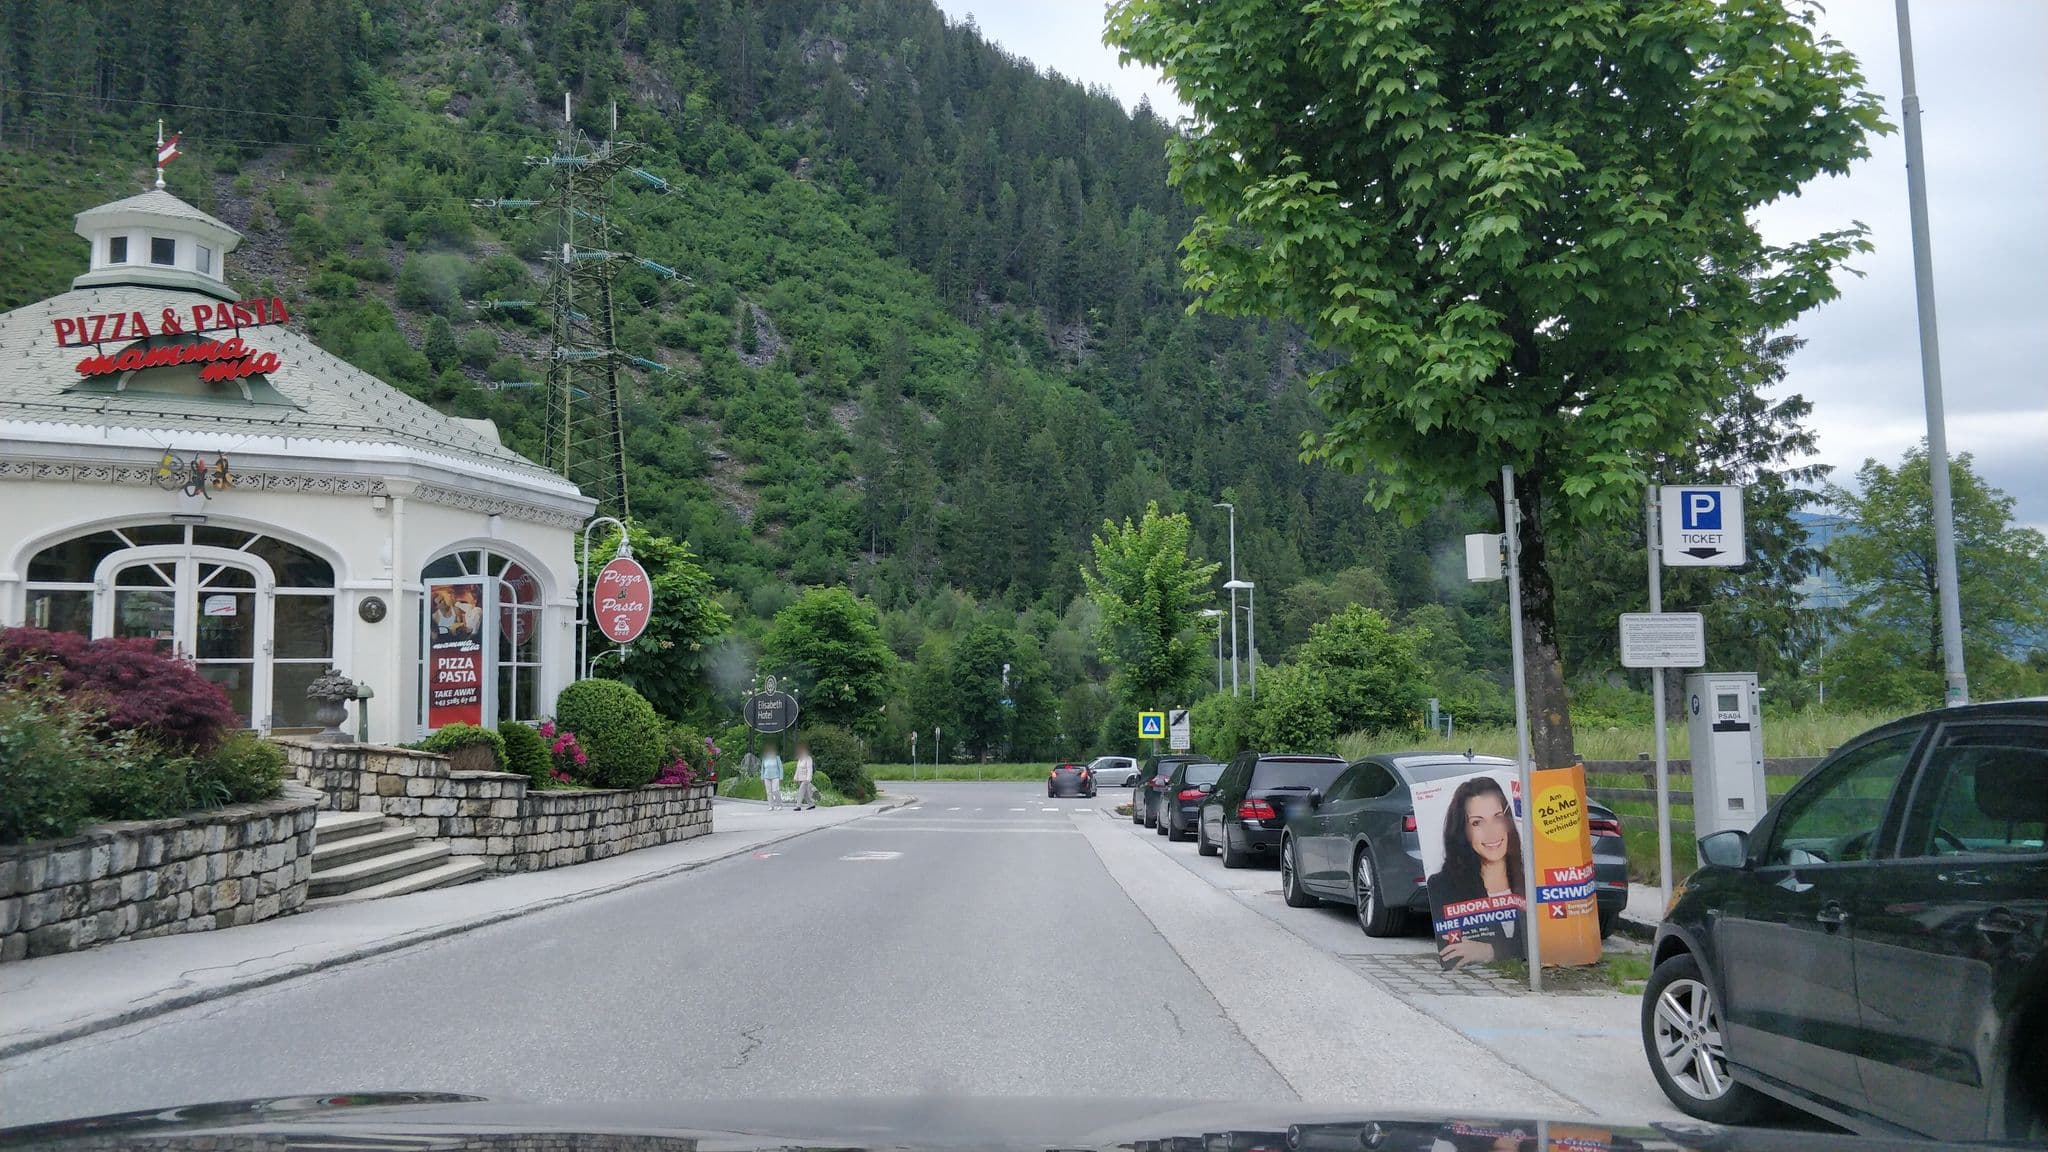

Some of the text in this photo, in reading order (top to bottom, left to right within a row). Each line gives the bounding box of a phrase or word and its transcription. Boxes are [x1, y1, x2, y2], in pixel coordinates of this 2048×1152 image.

[53, 296, 289, 347] PIZZA & PASTA
[75, 337, 250, 376] mamma
[200, 349, 281, 382] mia
[1690, 494, 1715, 527] P
[1681, 534, 1723, 544] TICKET
[604, 570, 642, 586] Pizza
[602, 598, 644, 613] Pasta
[438, 658, 474, 669] PIZZA
[439, 671, 476, 682] PASTA
[434, 688, 476, 698] TAKE AWAY
[758, 700, 783, 710] Elisabeth
[758, 710, 773, 720] Hotel
[1549, 793, 1562, 802] Am
[1538, 806, 1558, 818] 26.
[1446, 900, 1490, 917] EUROPA
[1436, 908, 1517, 932] IHRE ANTWORT
